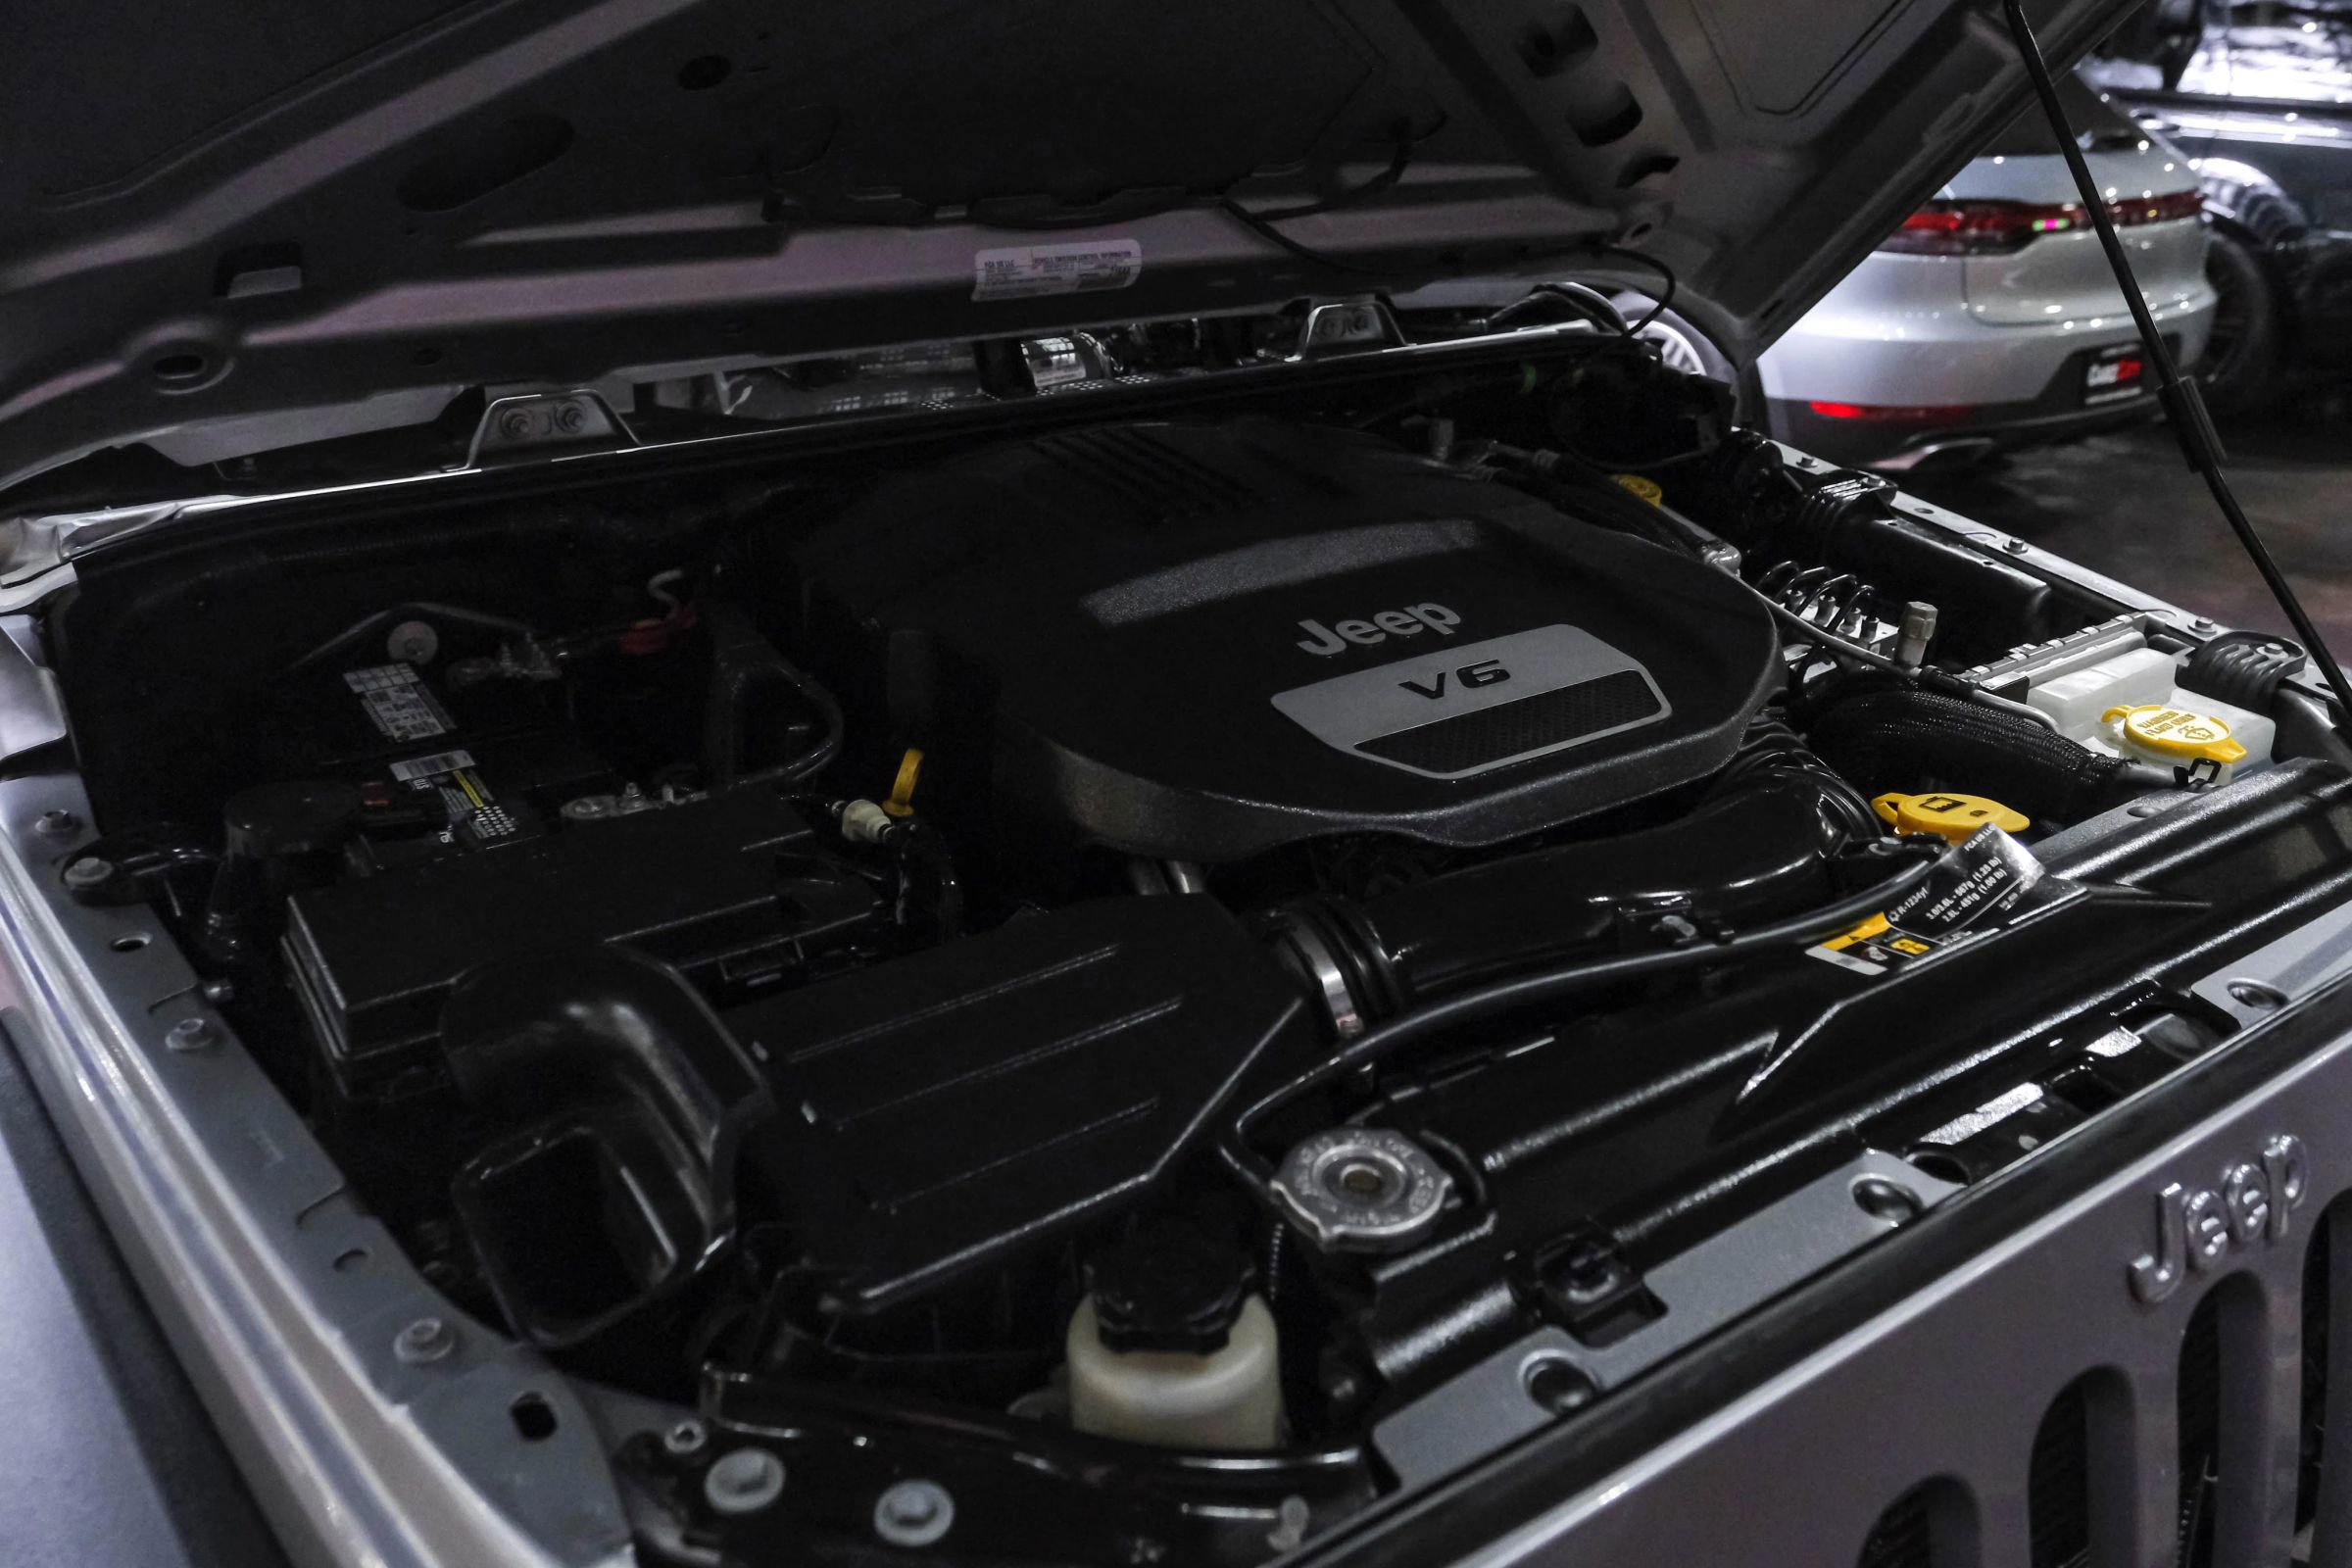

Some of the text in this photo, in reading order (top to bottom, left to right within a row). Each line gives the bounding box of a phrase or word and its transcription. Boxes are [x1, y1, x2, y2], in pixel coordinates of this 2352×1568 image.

[1296, 602, 1461, 658] Jeep
[1398, 659, 1511, 700] V6
[2127, 1134, 2308, 1304] Jeep
